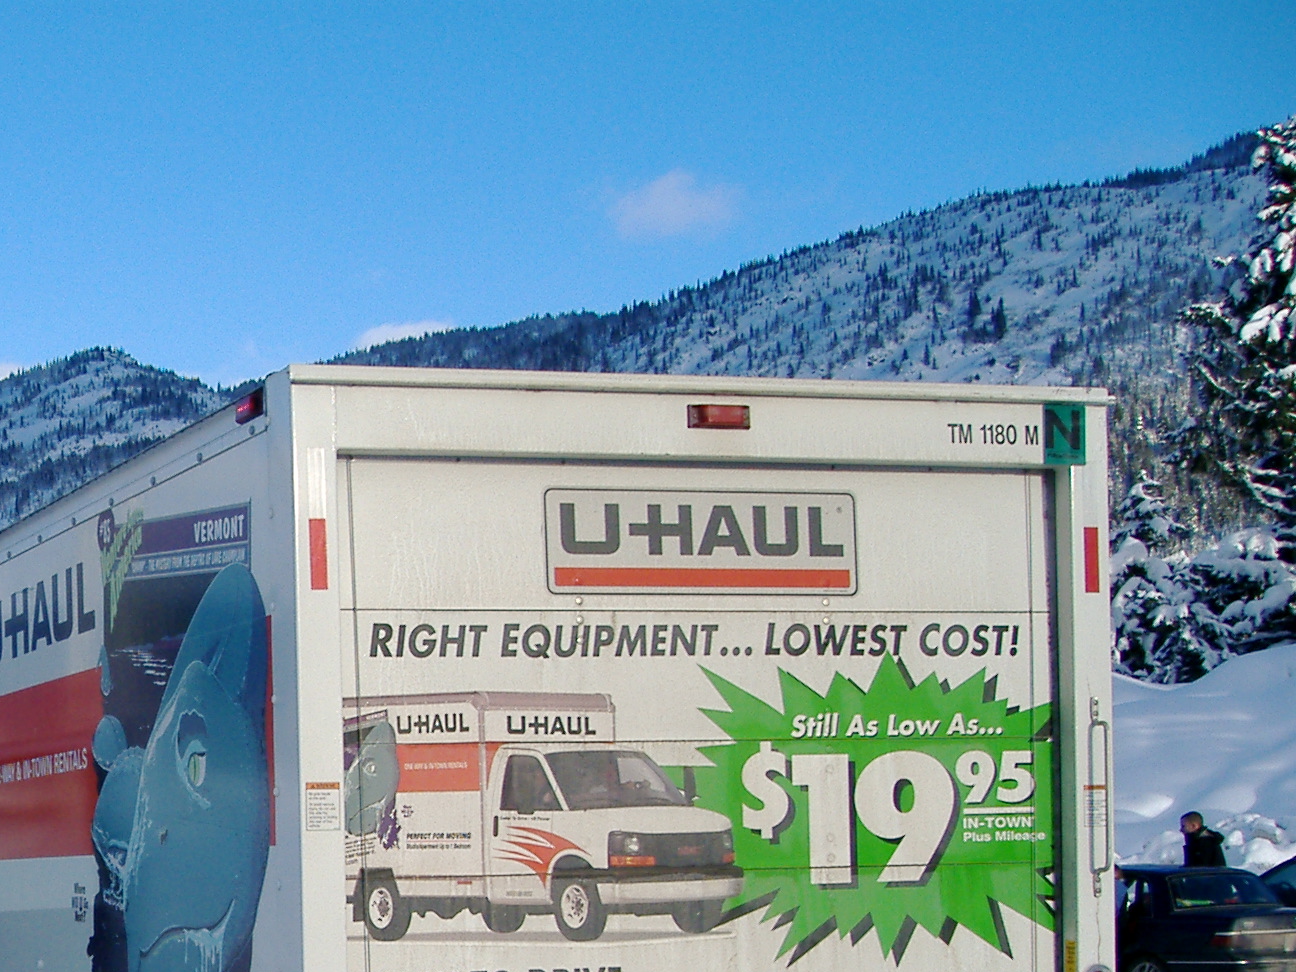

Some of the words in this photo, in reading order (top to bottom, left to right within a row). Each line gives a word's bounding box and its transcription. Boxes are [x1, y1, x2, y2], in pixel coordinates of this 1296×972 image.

[947, 424, 972, 444] TM
[980, 424, 1017, 445] 1180
[1025, 425, 1039, 445] M
[1045, 409, 1080, 450] N
[194, 514, 245, 544] VERMONT
[559, 503, 844, 557] U-HAUL
[369, 623, 488, 658] RIGHT
[501, 623, 753, 659] EQUIPMENT...
[764, 622, 908, 657] LOWEST
[919, 622, 1019, 657] COST!
[397, 713, 469, 734] U-HAUL
[507, 715, 596, 735] U-HAUL
[790, 712, 840, 738] Still
[846, 714, 879, 737] As
[887, 714, 940, 736] Low
[946, 713, 1003, 736] As...
[16, 761, 22, 781] &
[23, 755, 53, 780] IN-TOWN
[53, 747, 88, 774] RENTALS
[963, 816, 1032, 829] IN-TOWN
[406, 832, 431, 840] PERFECT
[433, 832, 444, 840] FOR
[446, 831, 471, 839] MOVING
[963, 832, 992, 842] Plus
[995, 830, 1046, 843] Mileage
